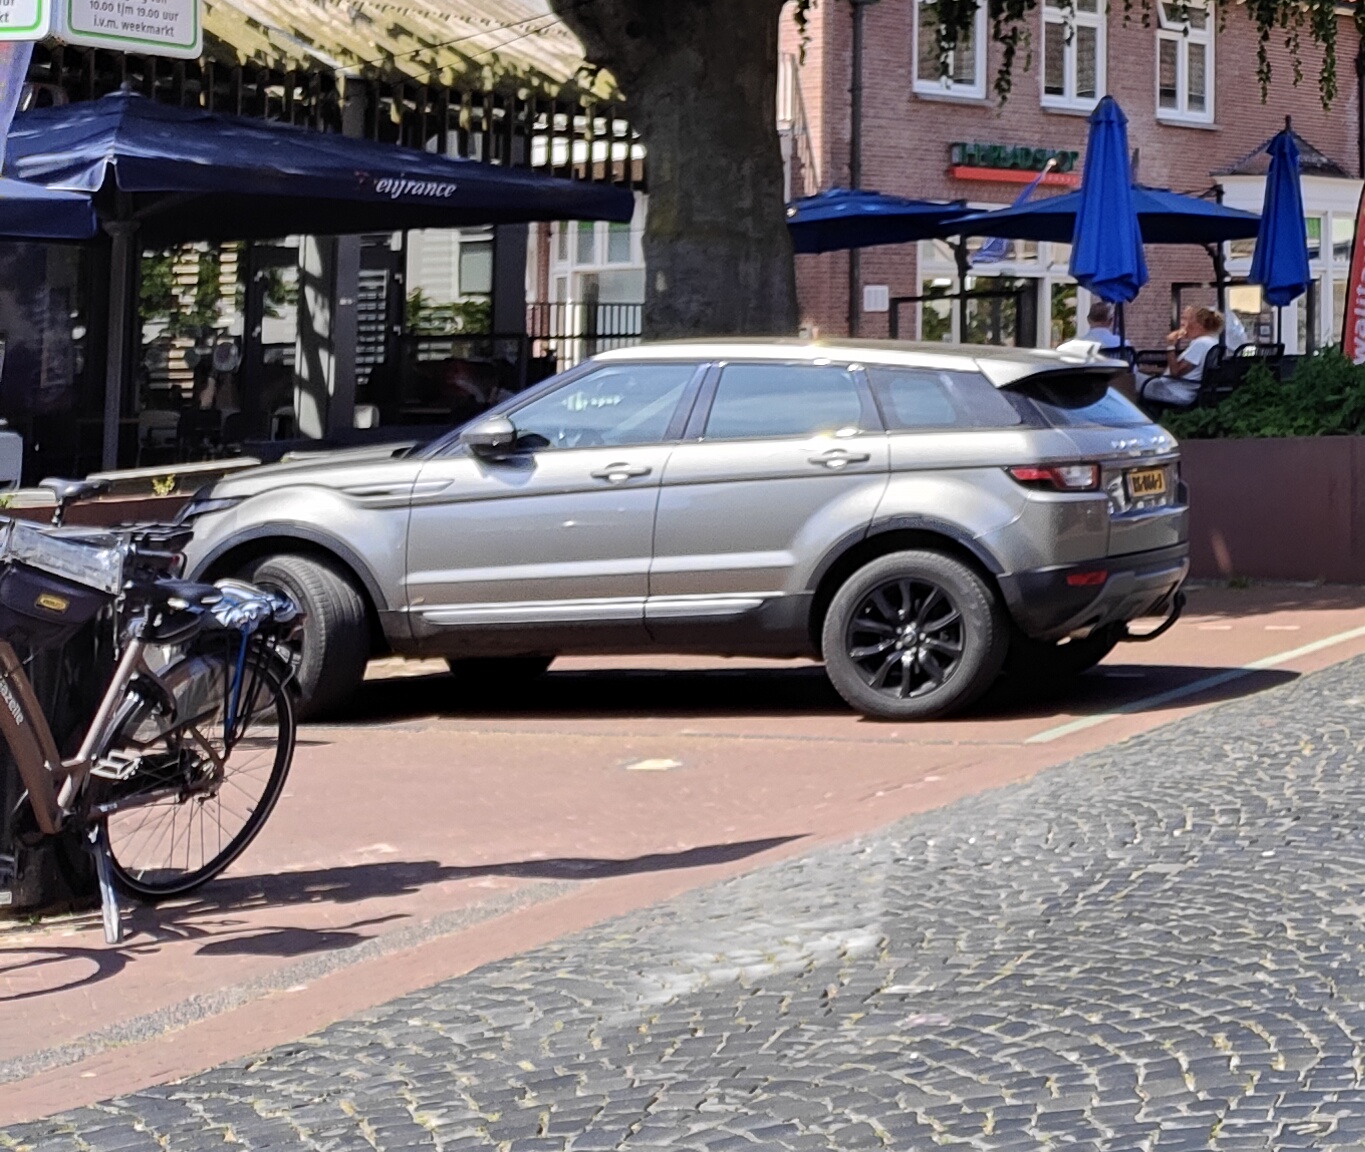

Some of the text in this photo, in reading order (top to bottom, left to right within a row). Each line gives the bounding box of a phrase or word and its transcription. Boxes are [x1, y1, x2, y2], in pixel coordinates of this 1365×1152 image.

[89, 0, 179, 22] 10.00 t/m 19.00 uur
[93, 14, 175, 38] i.v.m. weekmarkt
[0, 674, 25, 726] azelle
